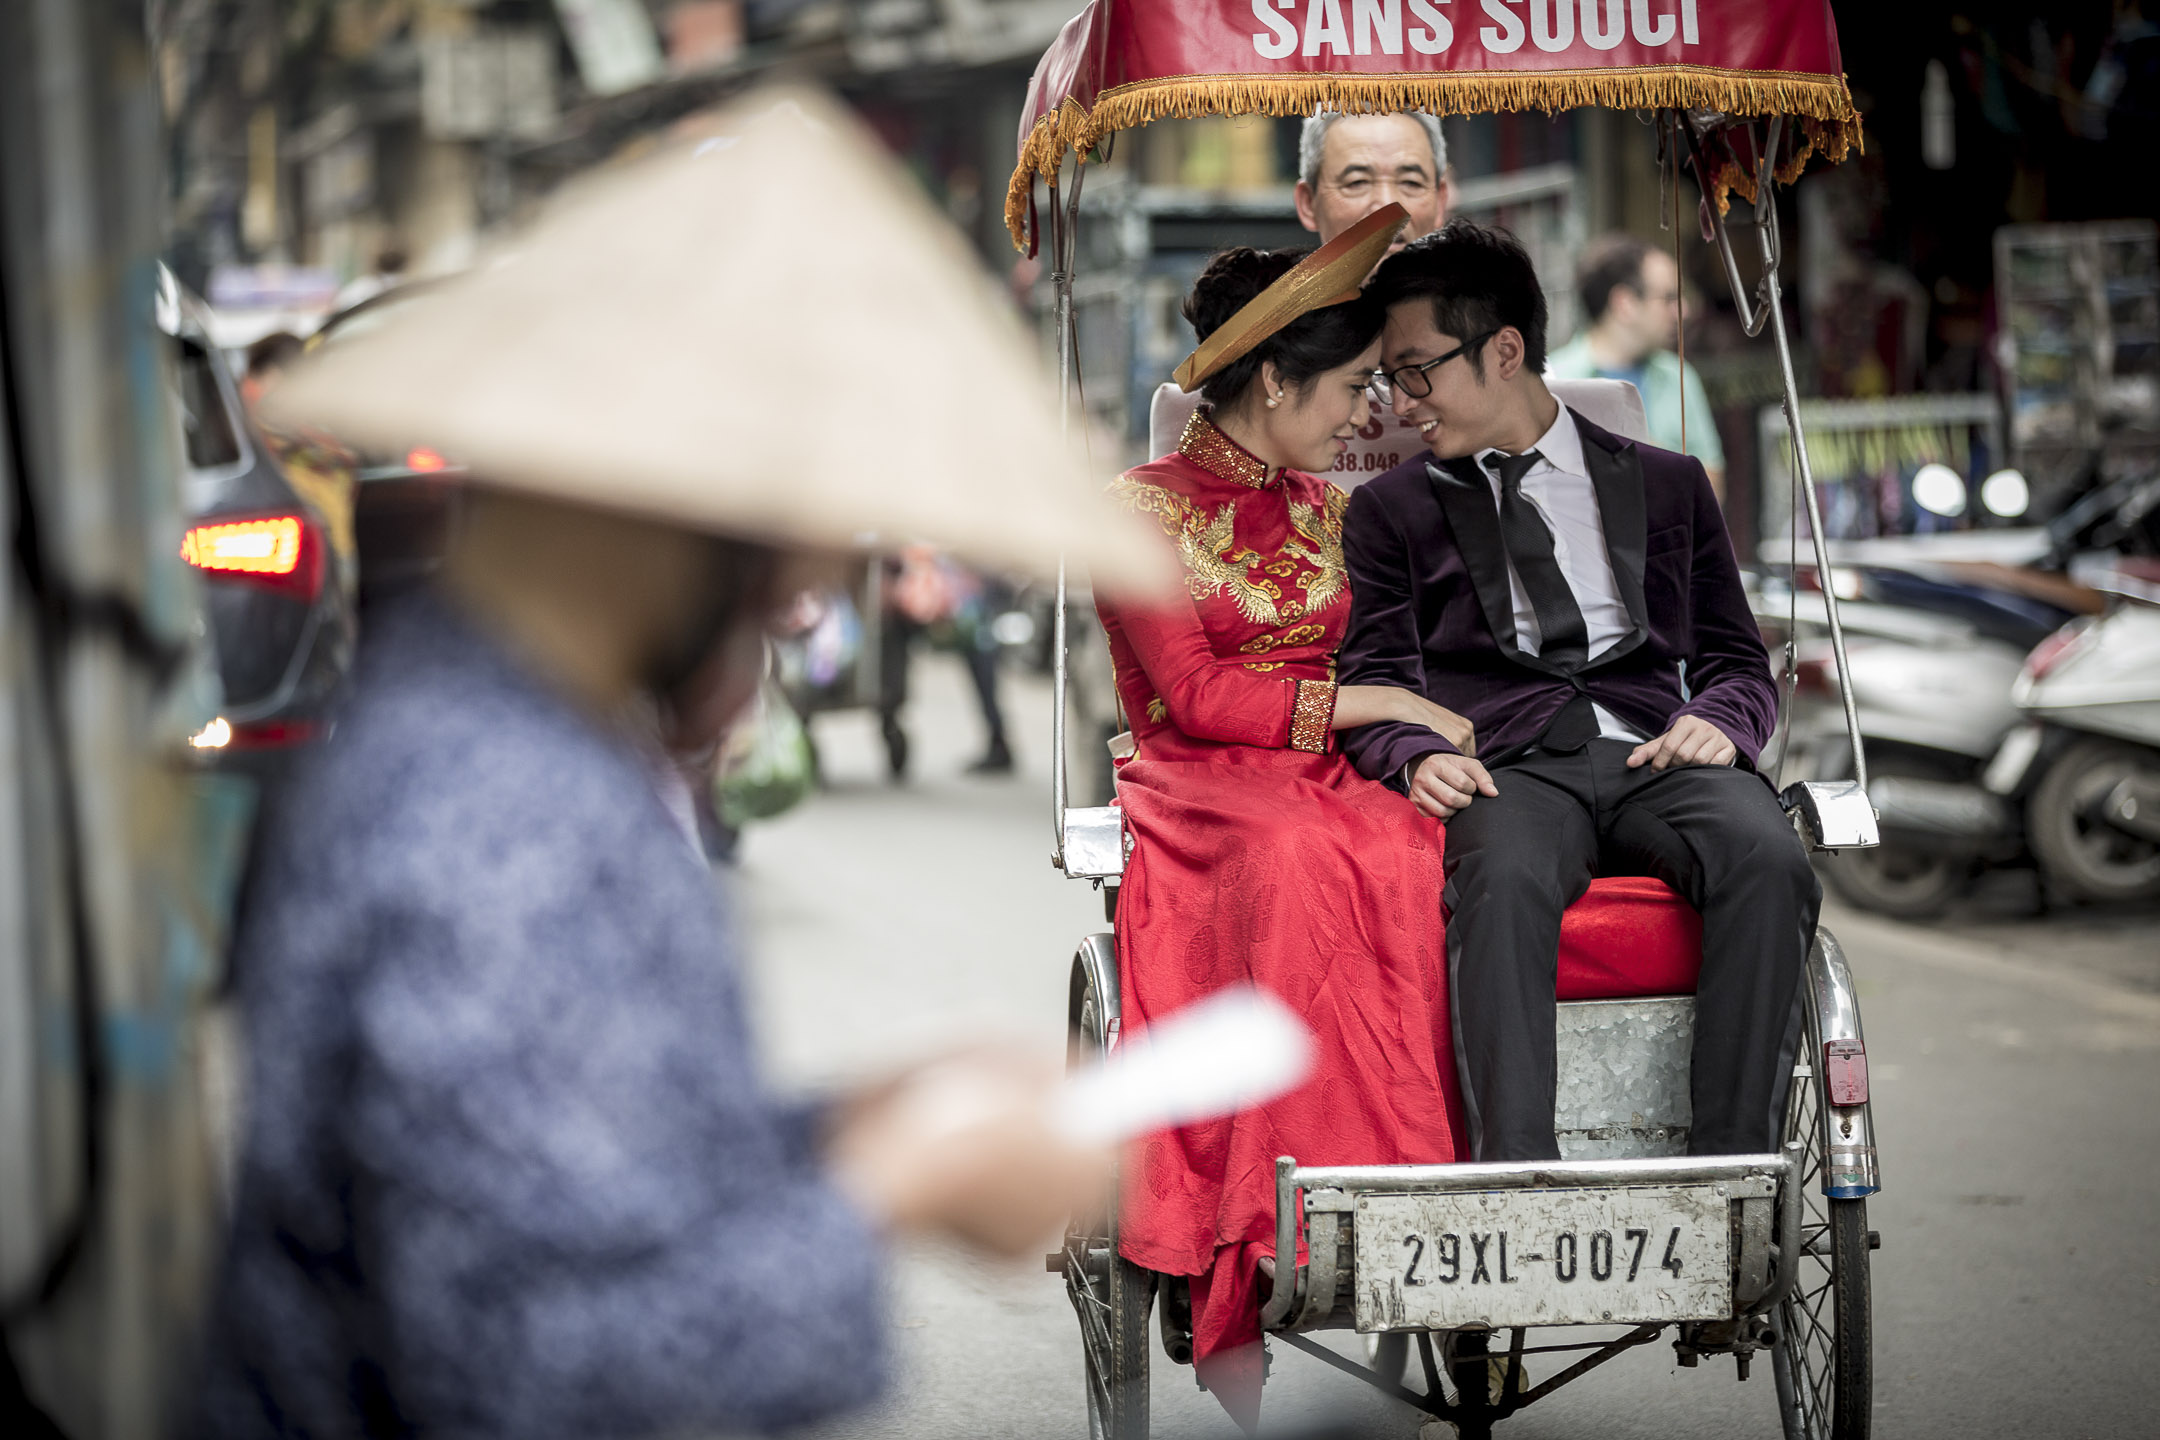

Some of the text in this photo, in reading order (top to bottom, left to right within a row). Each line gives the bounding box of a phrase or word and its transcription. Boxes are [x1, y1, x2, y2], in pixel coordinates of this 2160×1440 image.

[1251, 0, 1454, 59] SANS
[1328, 452, 1399, 472] 38.048
[1402, 1226, 1684, 1287] 29XL-0074
